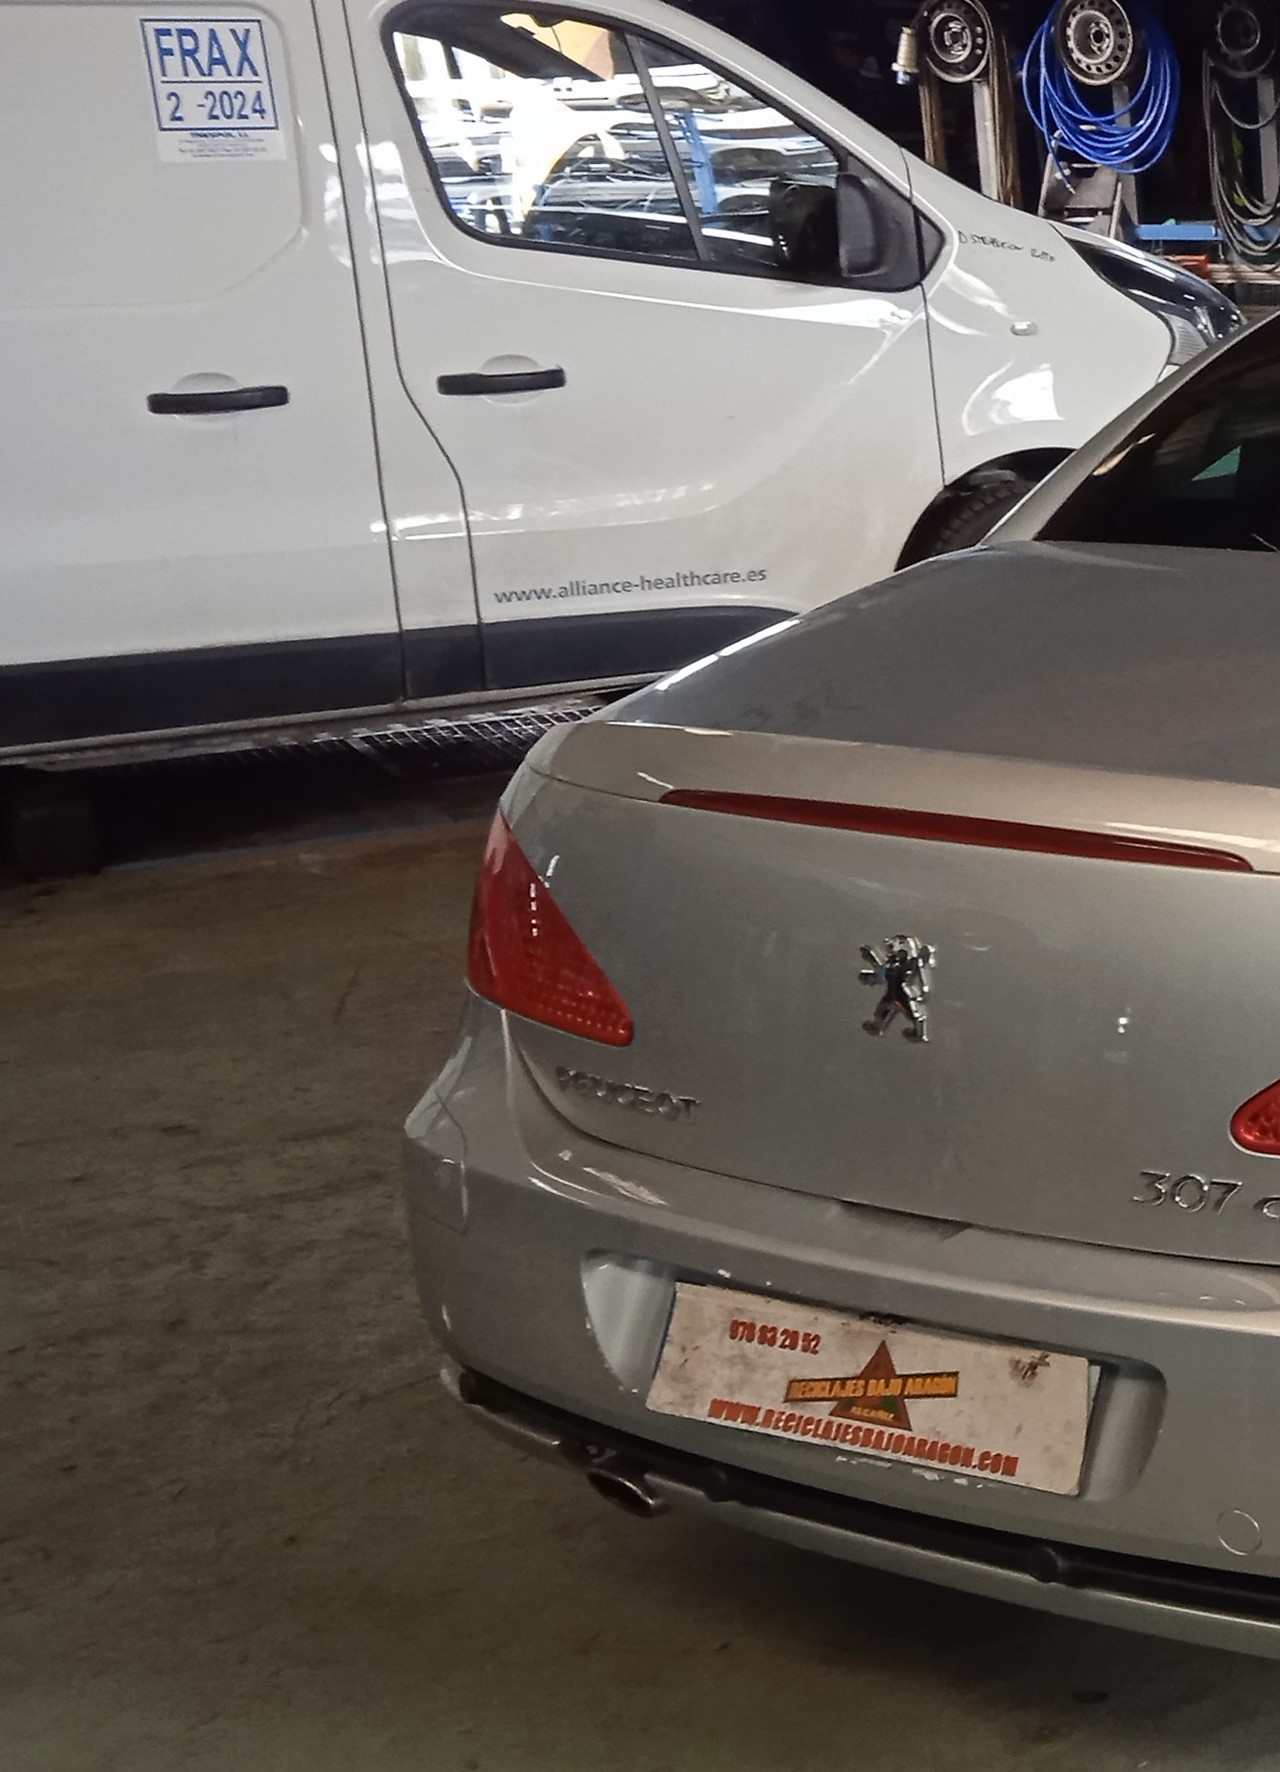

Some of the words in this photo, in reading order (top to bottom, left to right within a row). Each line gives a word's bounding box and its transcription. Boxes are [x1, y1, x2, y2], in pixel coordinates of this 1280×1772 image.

[153, 28, 259, 77] FRAX
[166, 91, 184, 121] 2
[494, 568, 768, 603] www.alliance-healthcare.es
[1130, 1168, 1243, 1216] 307
[708, 1397, 1019, 1477] WWW.RECICLAJESBAJOARAGON.COM
